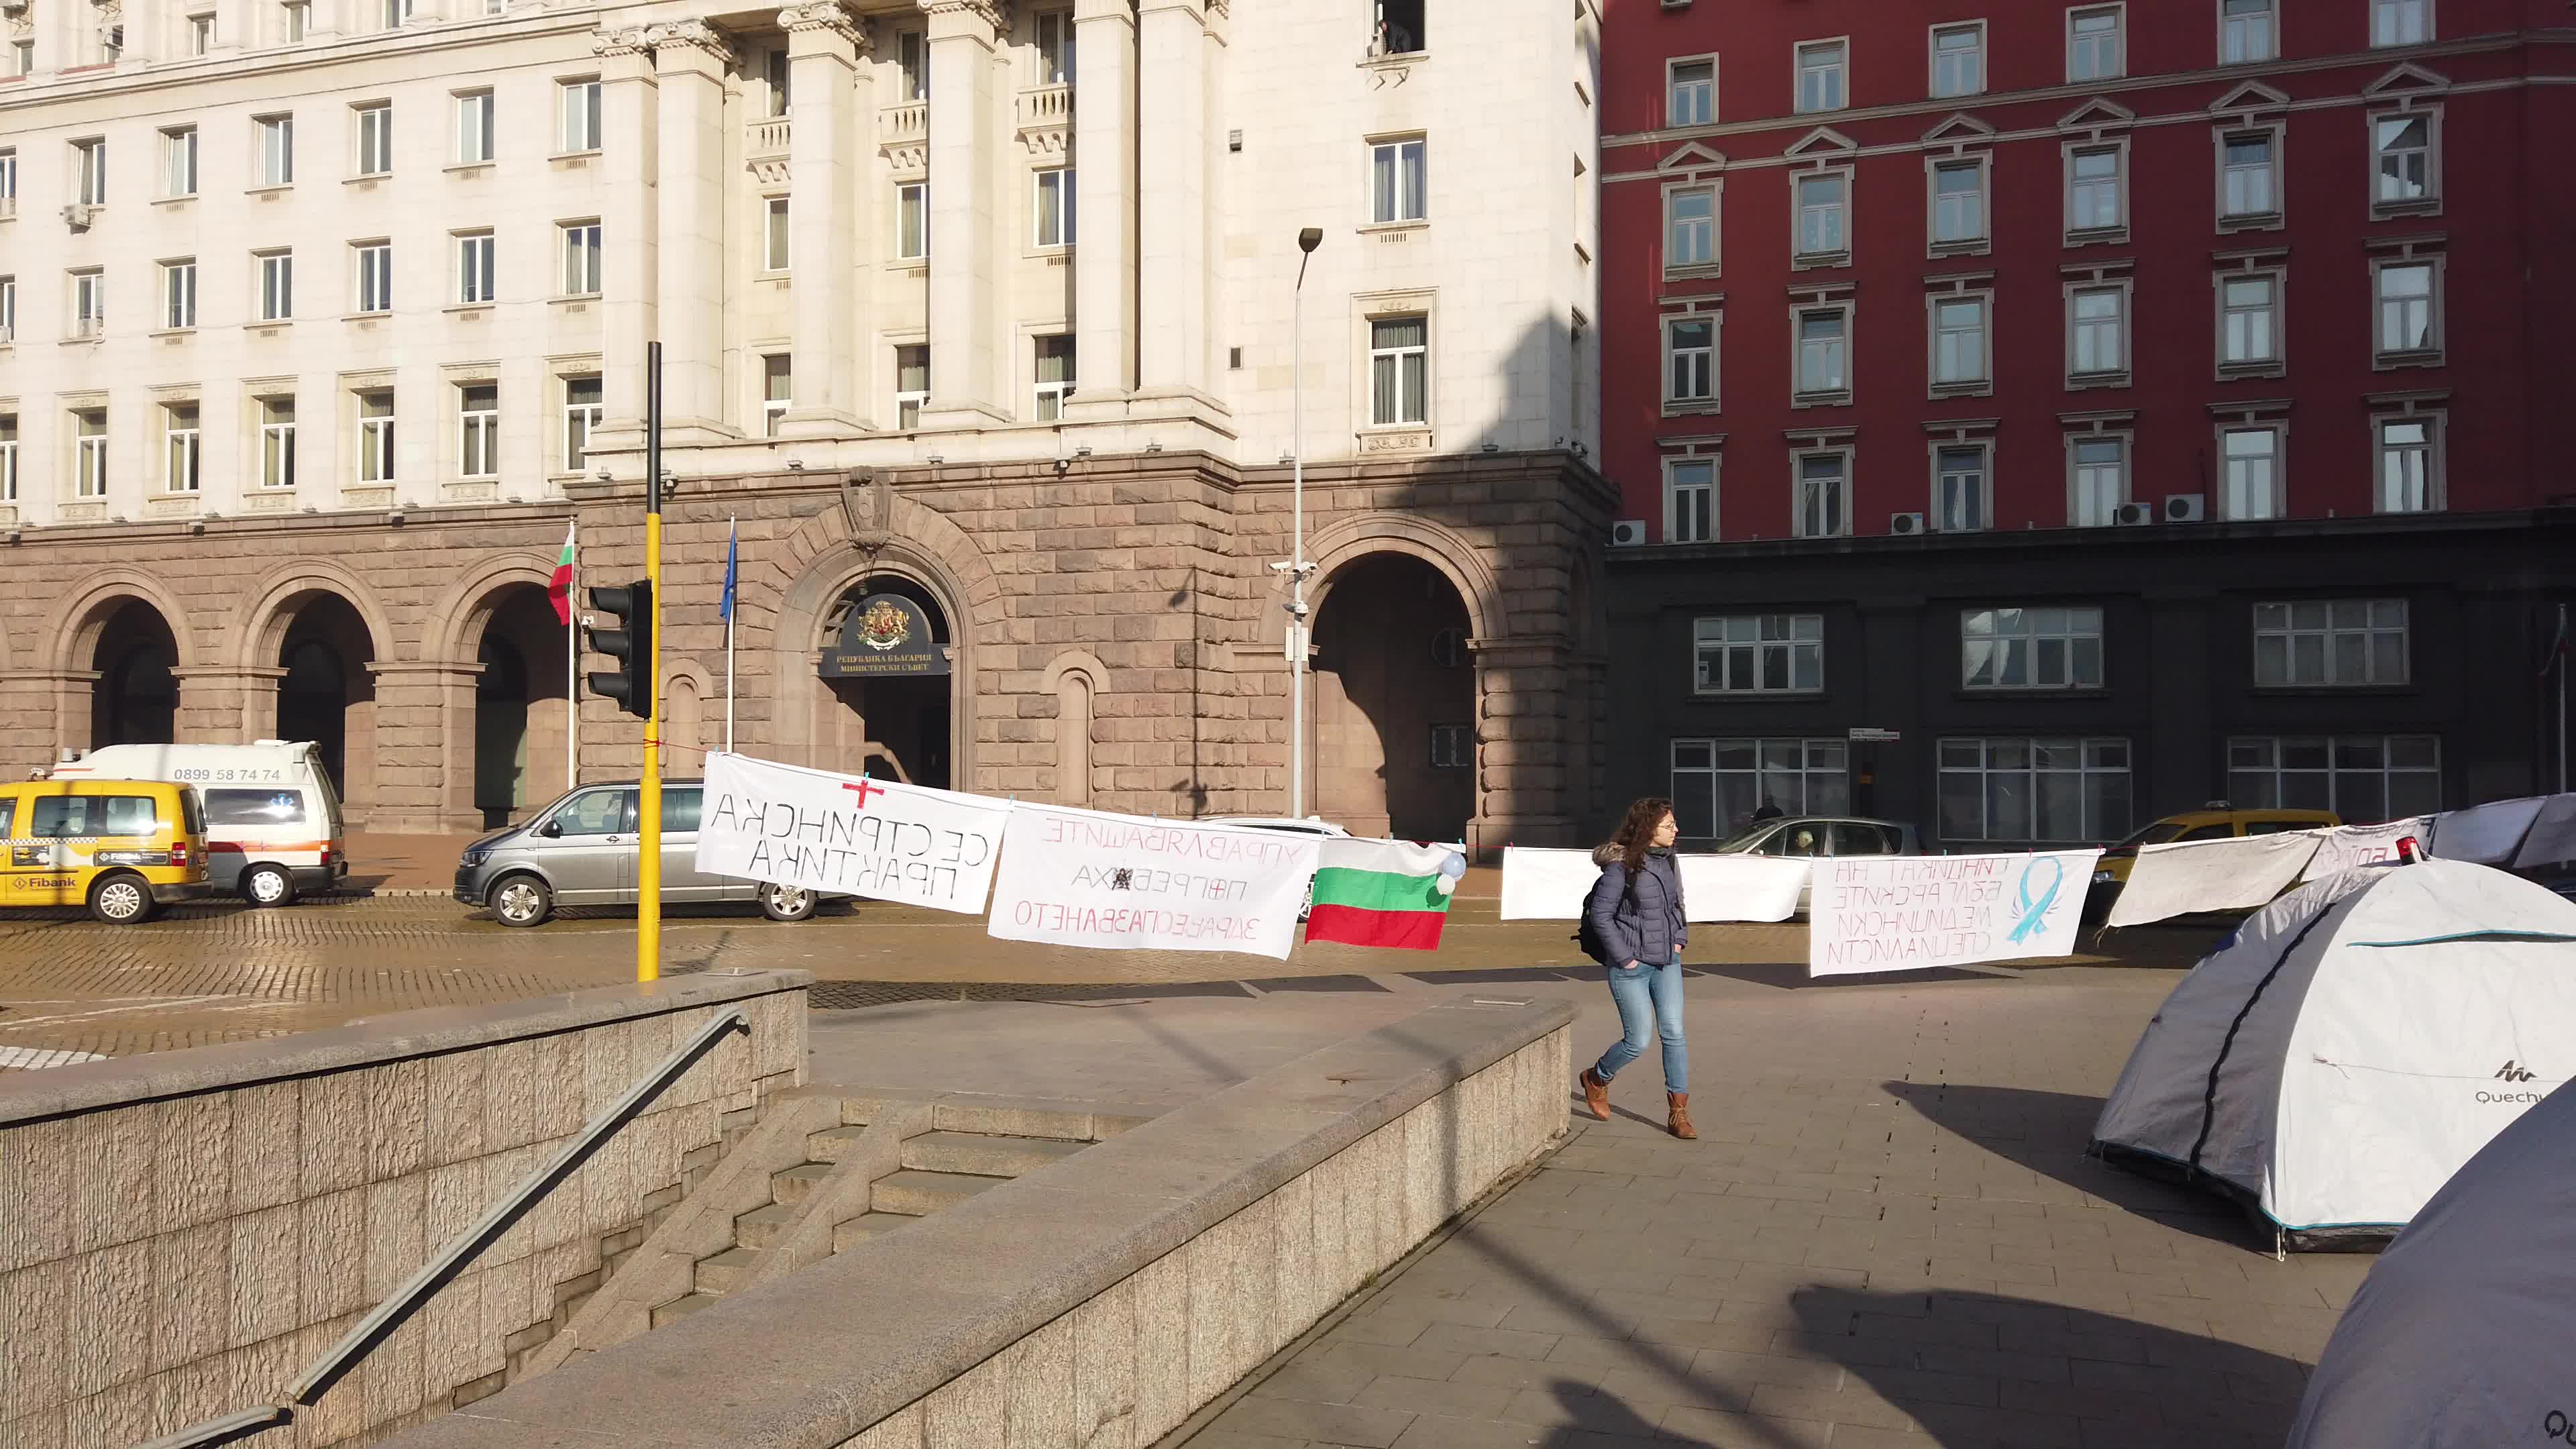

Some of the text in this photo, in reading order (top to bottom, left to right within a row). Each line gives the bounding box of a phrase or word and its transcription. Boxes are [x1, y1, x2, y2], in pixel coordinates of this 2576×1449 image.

[837, 654, 932, 663] РЕПУБЛИКА БЪЛГАРИЯ
[841, 664, 900, 672] МИНИСТЕРСКИ
[174, 769, 280, 780] 0899 58 74 74
[29, 877, 76, 887] Fibank
